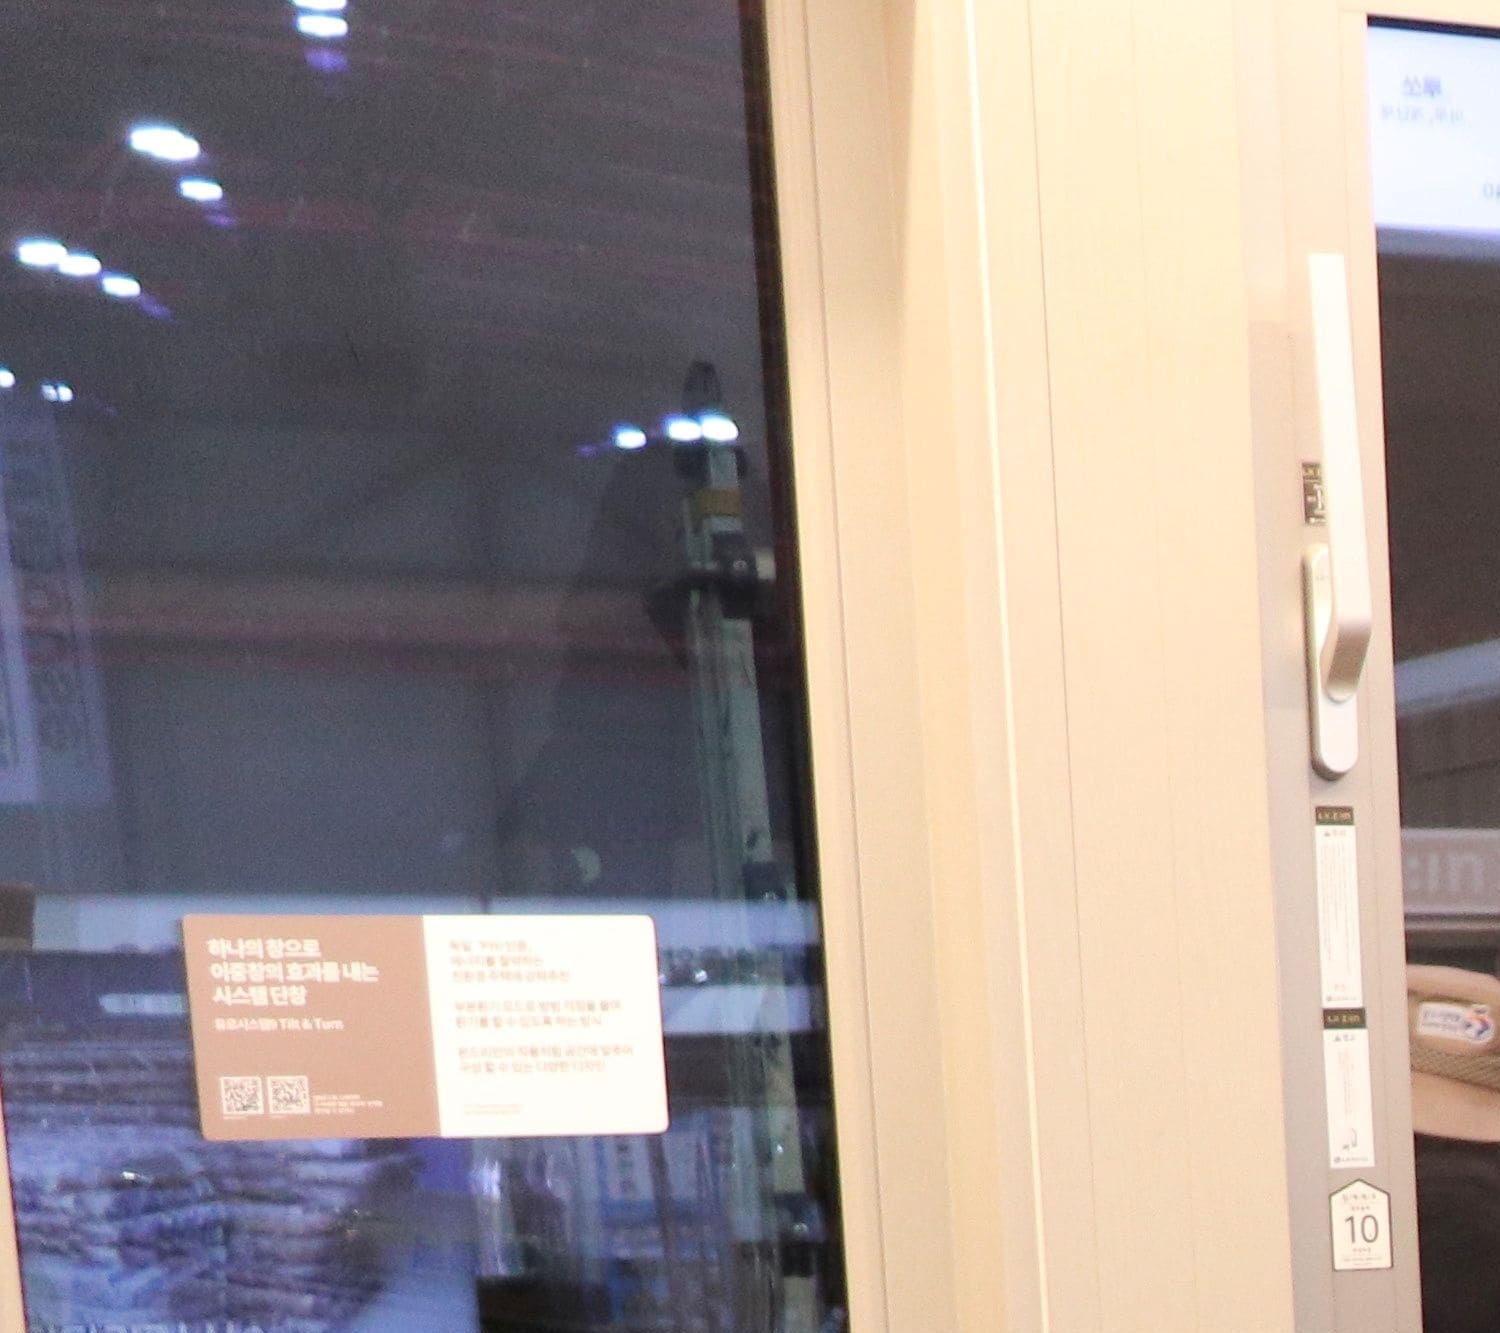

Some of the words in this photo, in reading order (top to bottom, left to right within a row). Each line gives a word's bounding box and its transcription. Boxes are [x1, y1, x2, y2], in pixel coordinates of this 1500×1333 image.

[207, 938, 264, 959] 하나의
[266, 938, 322, 959] 창으로
[210, 961, 284, 983] 이중창의
[286, 961, 340, 983] 효과를
[342, 962, 380, 982] 내는
[212, 985, 268, 1006] 시스템
[271, 985, 307, 1006] 단창
[314, 1018, 344, 1030] Turn
[1344, 1214, 1379, 1244] 10
